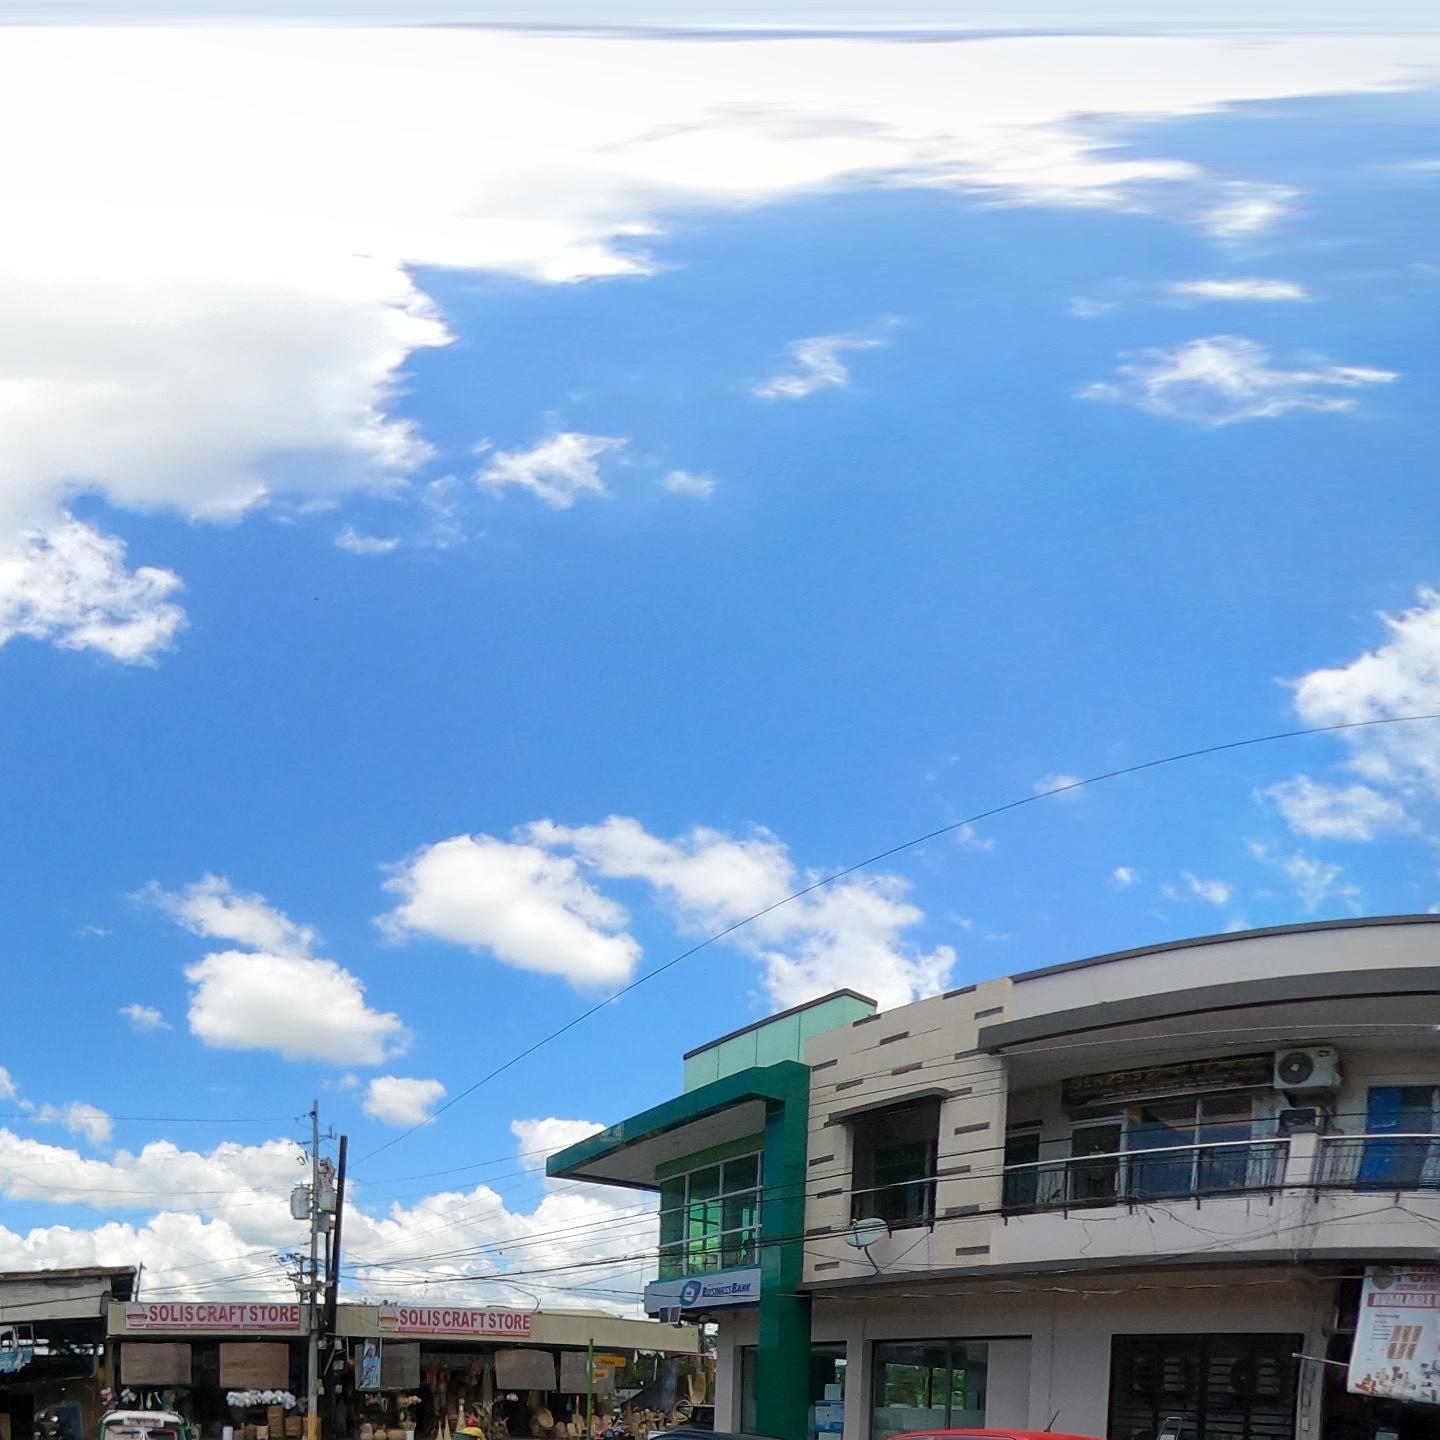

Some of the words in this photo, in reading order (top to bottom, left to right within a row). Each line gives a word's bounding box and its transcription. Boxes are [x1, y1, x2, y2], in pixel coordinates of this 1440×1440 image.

[149, 1305, 194, 1322] SOLIS
[196, 1305, 246, 1322] CRAFT
[250, 1305, 299, 1322] STORE
[399, 1309, 440, 1326] SOLIS
[442, 1311, 487, 1328] CRAFT
[489, 1313, 531, 1330] STORE
